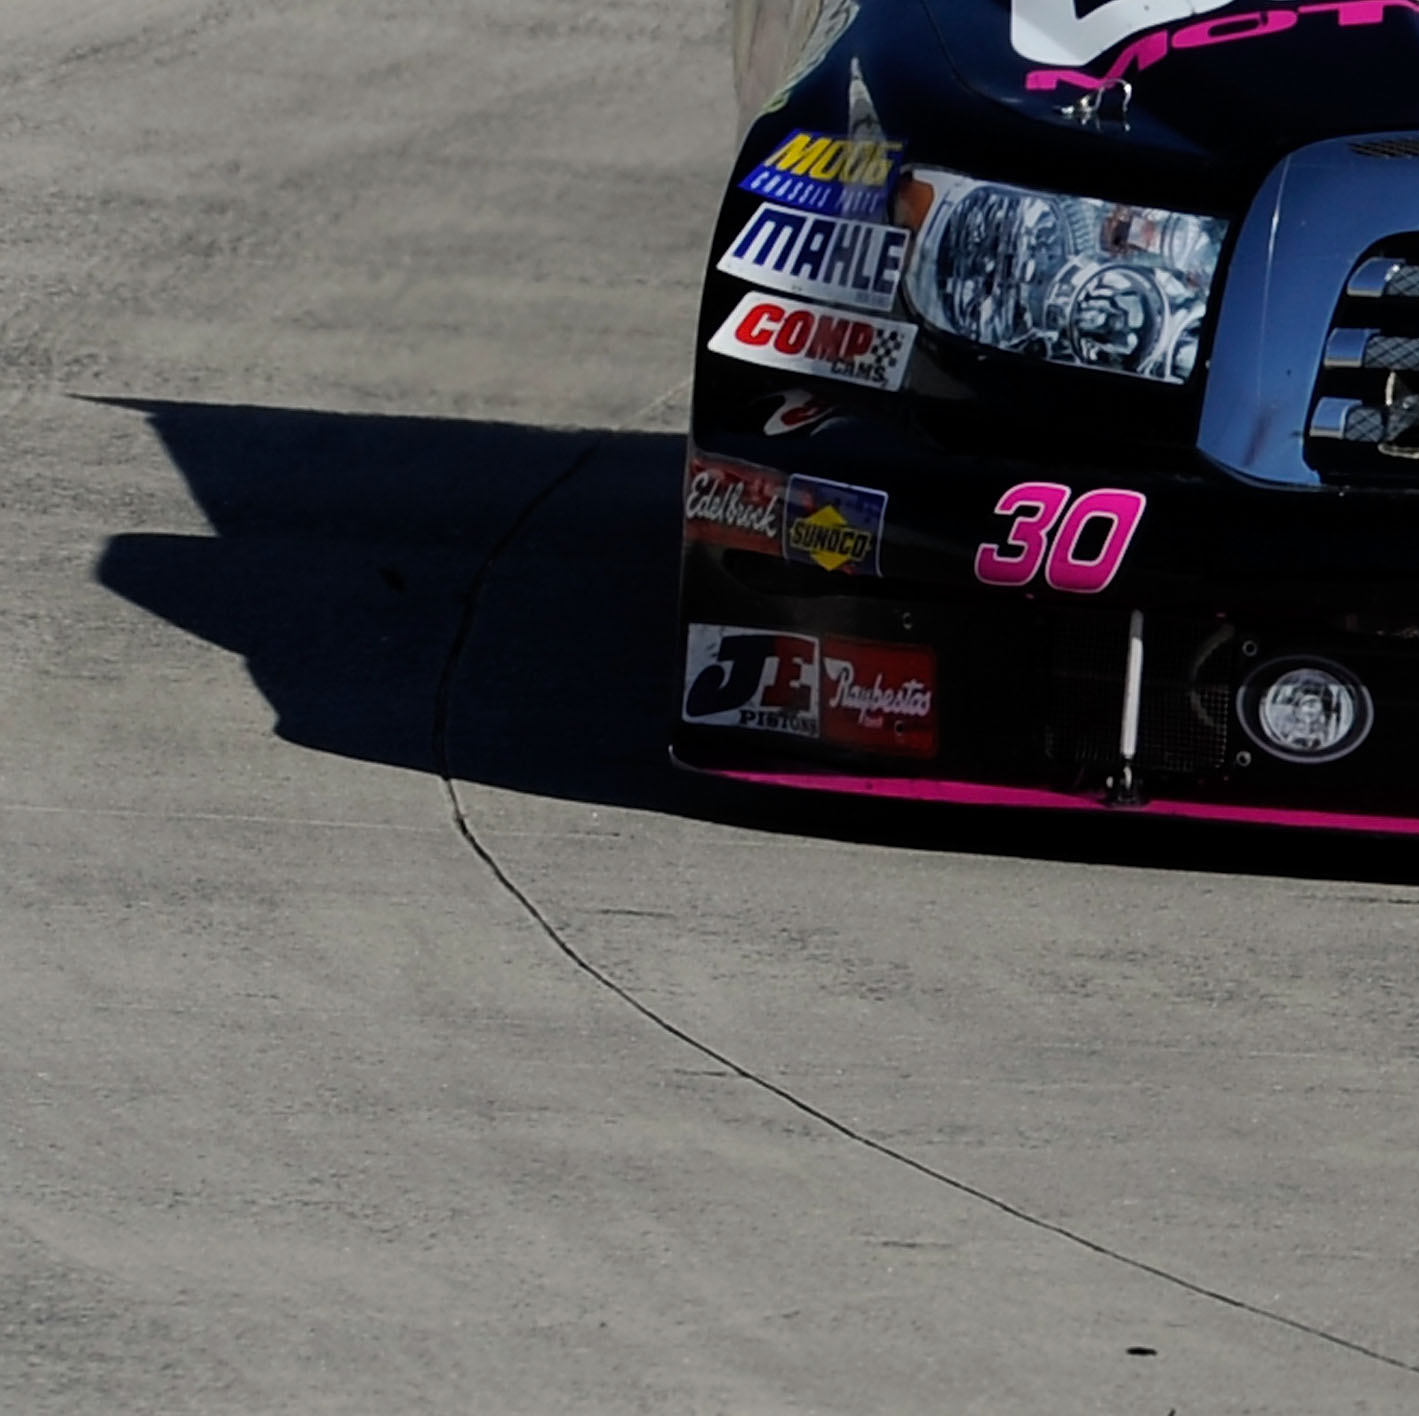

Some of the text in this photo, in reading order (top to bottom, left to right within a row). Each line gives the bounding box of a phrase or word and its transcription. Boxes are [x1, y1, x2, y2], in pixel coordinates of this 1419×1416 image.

[764, 132, 903, 187] MOOG
[733, 207, 906, 295] MAHLE
[735, 303, 875, 362] COMP
[831, 358, 889, 385] CAMS
[792, 520, 870, 560] SUNOCO
[975, 482, 1146, 593] 30
[686, 635, 817, 717] JE
[823, 657, 933, 726] Raybestos
[738, 708, 820, 735] PISTONS
